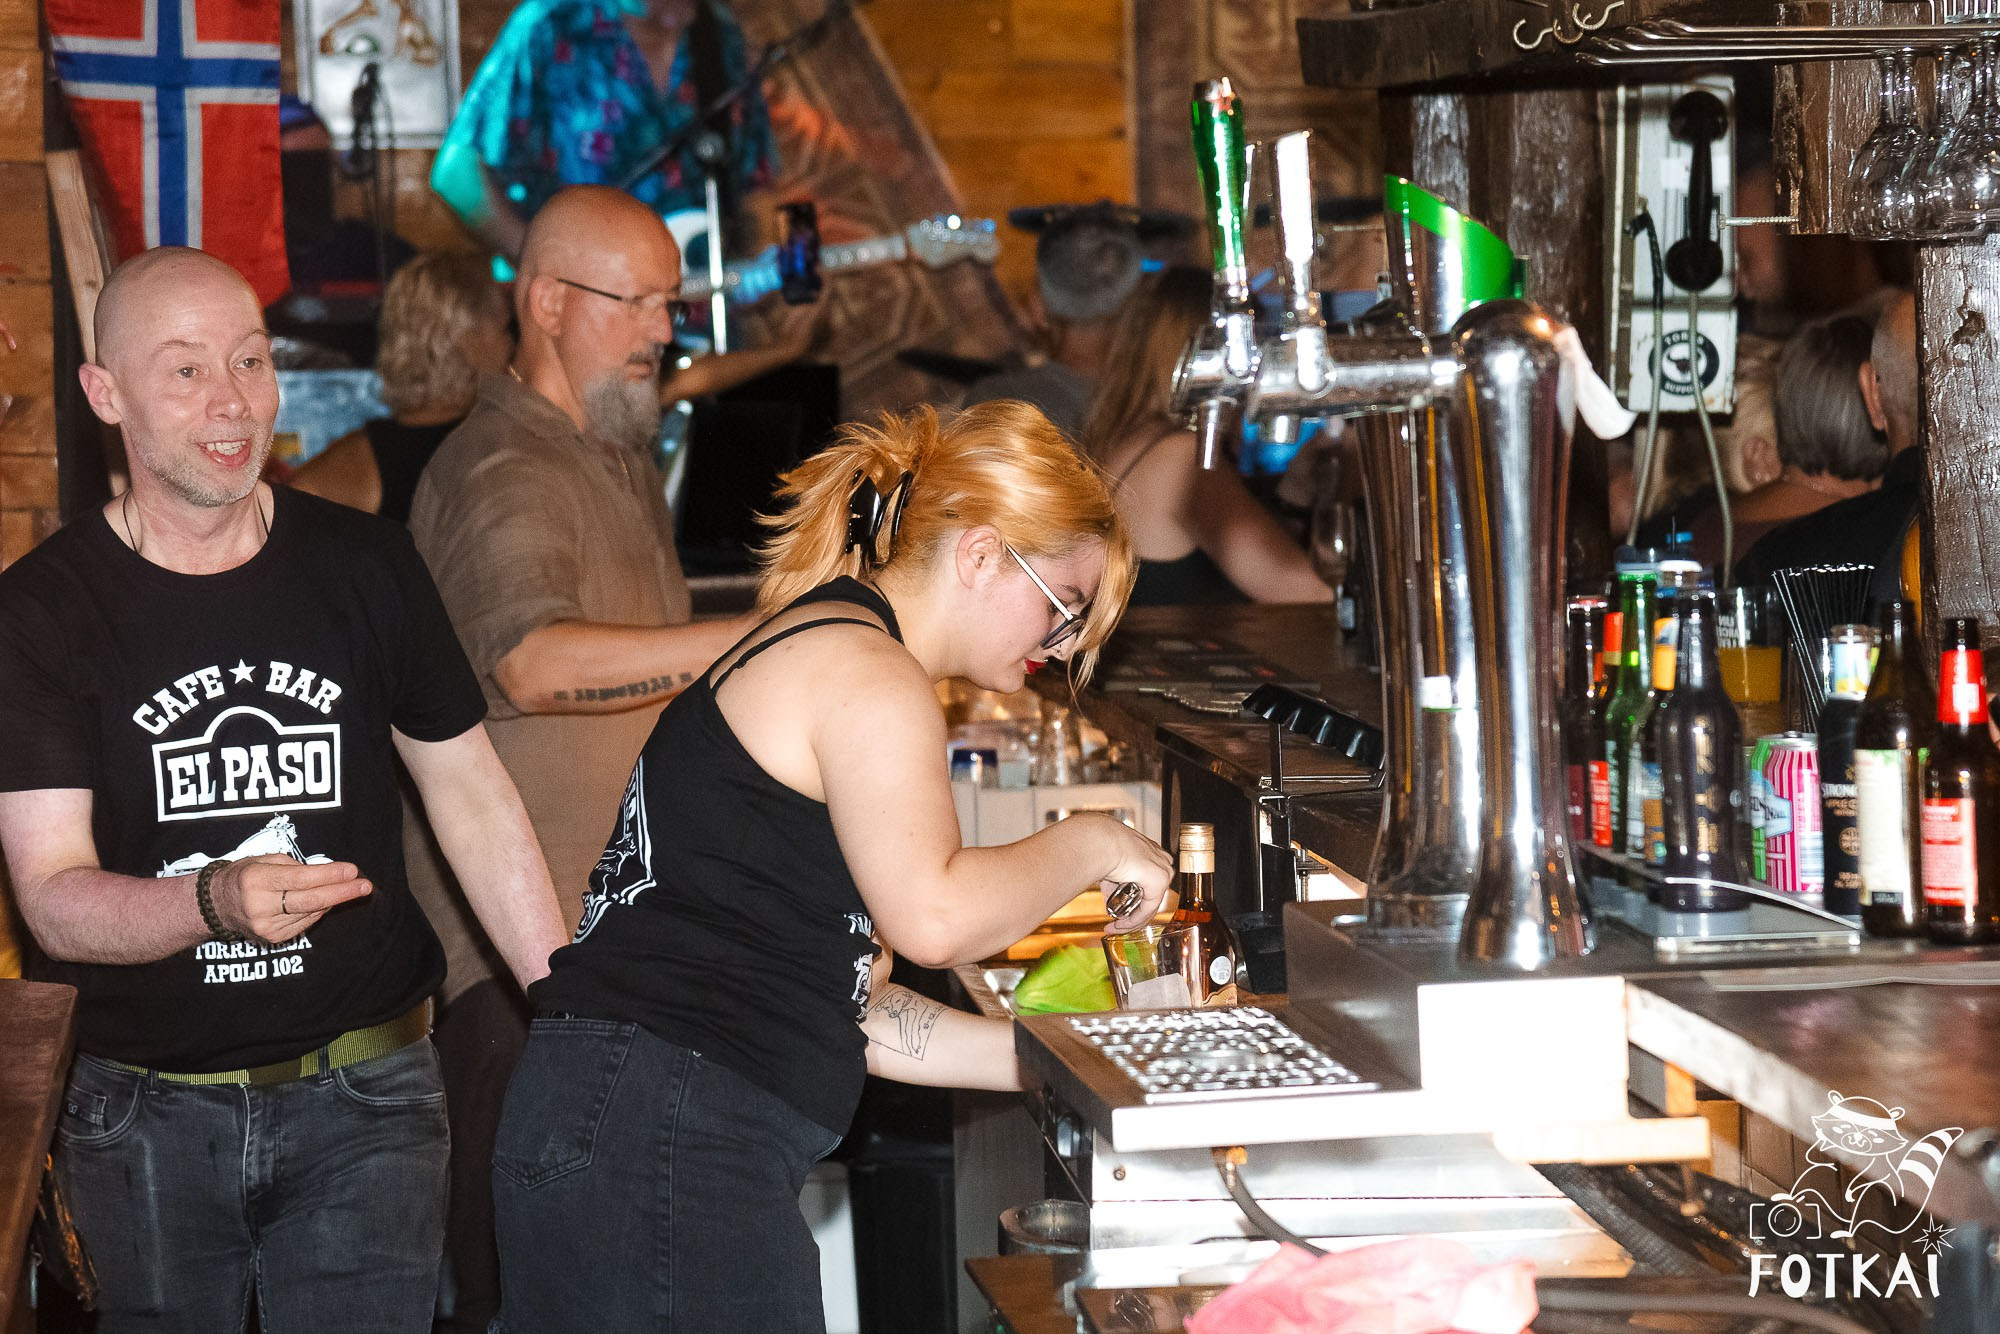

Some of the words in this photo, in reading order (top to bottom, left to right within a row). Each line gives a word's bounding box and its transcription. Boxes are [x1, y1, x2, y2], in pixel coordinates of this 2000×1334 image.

[1664, 332, 1705, 345] TORS
[132, 665, 225, 735] CAFE
[265, 660, 342, 714] BAR
[167, 751, 217, 809] EL
[221, 740, 332, 802] PASO
[195, 936, 313, 960] TORREA
[204, 961, 267, 983] APOLO
[272, 955, 304, 978] 102
